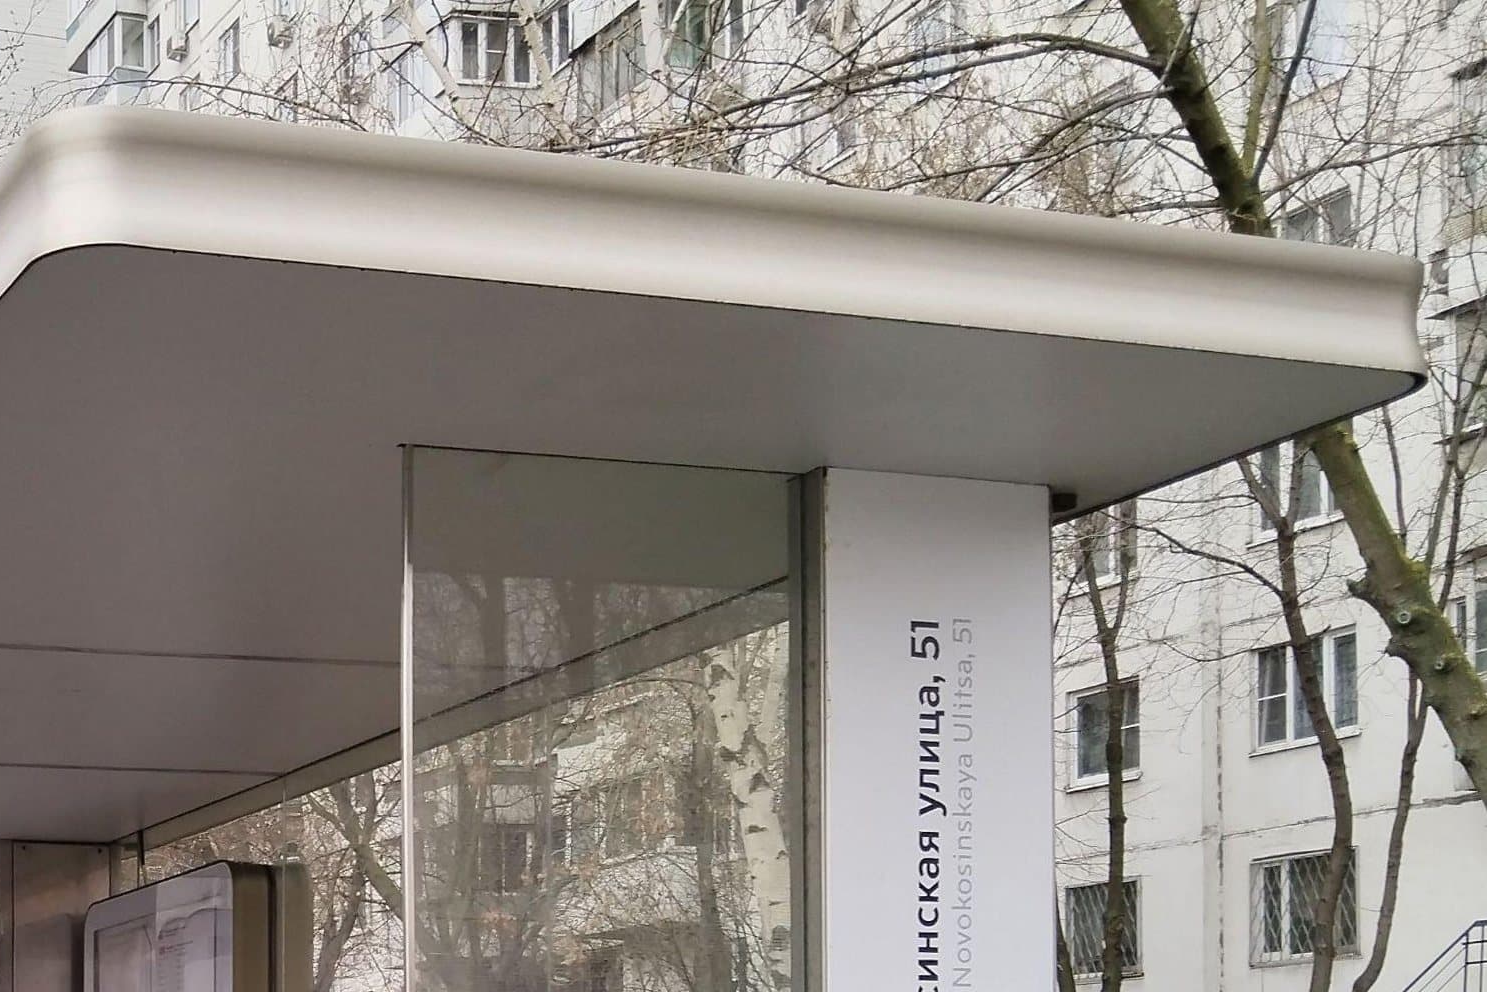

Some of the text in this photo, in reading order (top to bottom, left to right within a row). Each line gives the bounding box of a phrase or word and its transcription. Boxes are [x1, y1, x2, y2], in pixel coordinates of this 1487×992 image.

[910, 619, 941, 661] 51
[918, 674, 948, 817] улица,
[951, 617, 978, 988] Novokosinskaya Ulitsa, 51
